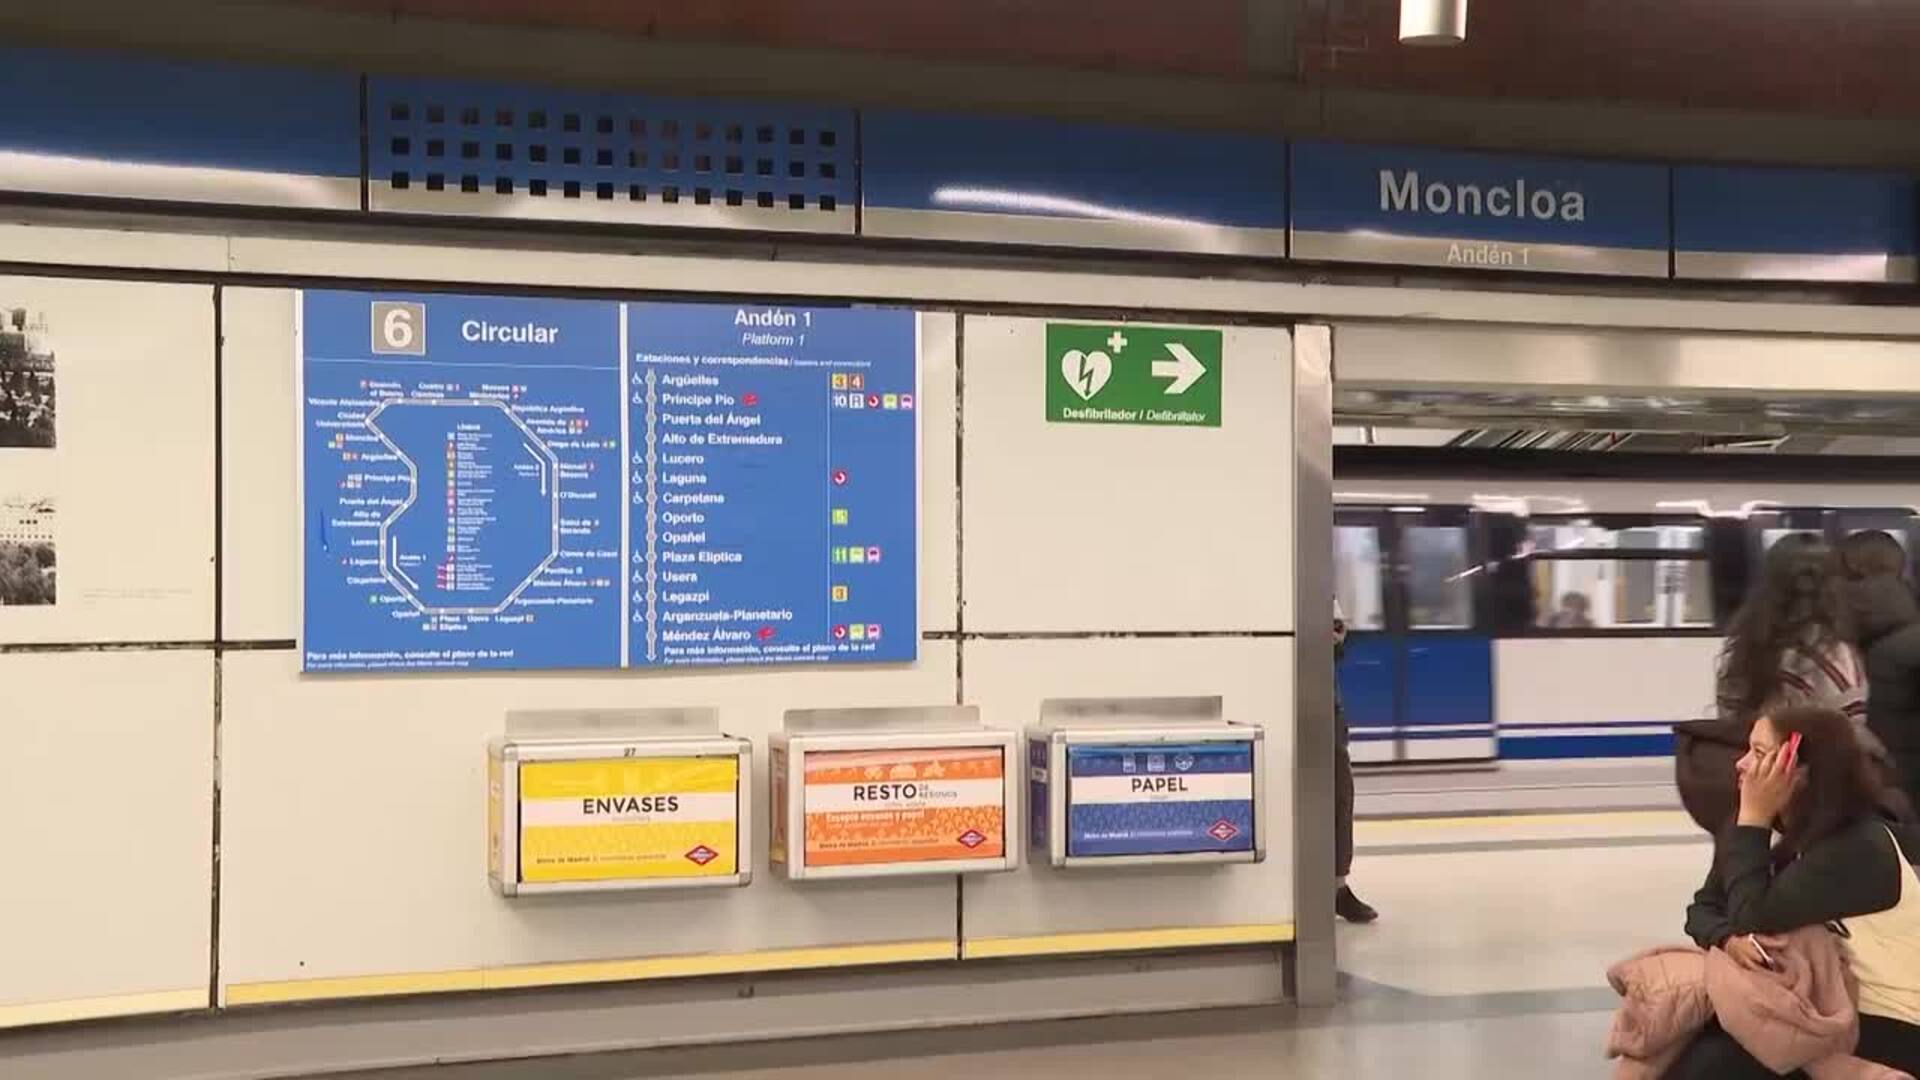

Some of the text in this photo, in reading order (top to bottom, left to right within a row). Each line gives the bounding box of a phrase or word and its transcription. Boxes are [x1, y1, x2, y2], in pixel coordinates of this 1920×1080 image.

[1379, 169, 1585, 222] Moncloa
[1447, 244, 1529, 265] Andén 1
[734, 309, 812, 327] Andén 1
[384, 308, 413, 347] 6
[462, 320, 558, 344] Circular
[742, 333, 805, 346] Platform 1
[636, 354, 691, 363] Estaciones
[693, 356, 700, 366] y
[702, 356, 788, 366] correspondencias
[662, 374, 719, 387] Argüelles
[833, 395, 847, 407] 10
[662, 410, 761, 428] Puerta del Ángel
[1063, 407, 1136, 421] Desfibrilador
[662, 433, 782, 445] Alto de Extremadura
[662, 452, 704, 465] Lucero
[662, 471, 707, 486] Laguna
[662, 492, 725, 506] Carpetana
[662, 511, 705, 525] Oporto
[662, 531, 706, 545] Opañel
[662, 551, 695, 563] Plaza
[662, 571, 698, 582] Usera
[662, 590, 709, 605] Legazpi
[662, 610, 793, 624] Arganzuela-Planetario
[662, 626, 751, 641] Méndez Álvaro
[500, 649, 514, 658] red
[664, 646, 684, 656] Para
[686, 646, 706, 655] más
[838, 643, 849, 652] de
[862, 643, 876, 651] red
[853, 783, 917, 801] RESTO
[1131, 777, 1188, 793] PAPEL
[583, 796, 679, 814] ENVASES
